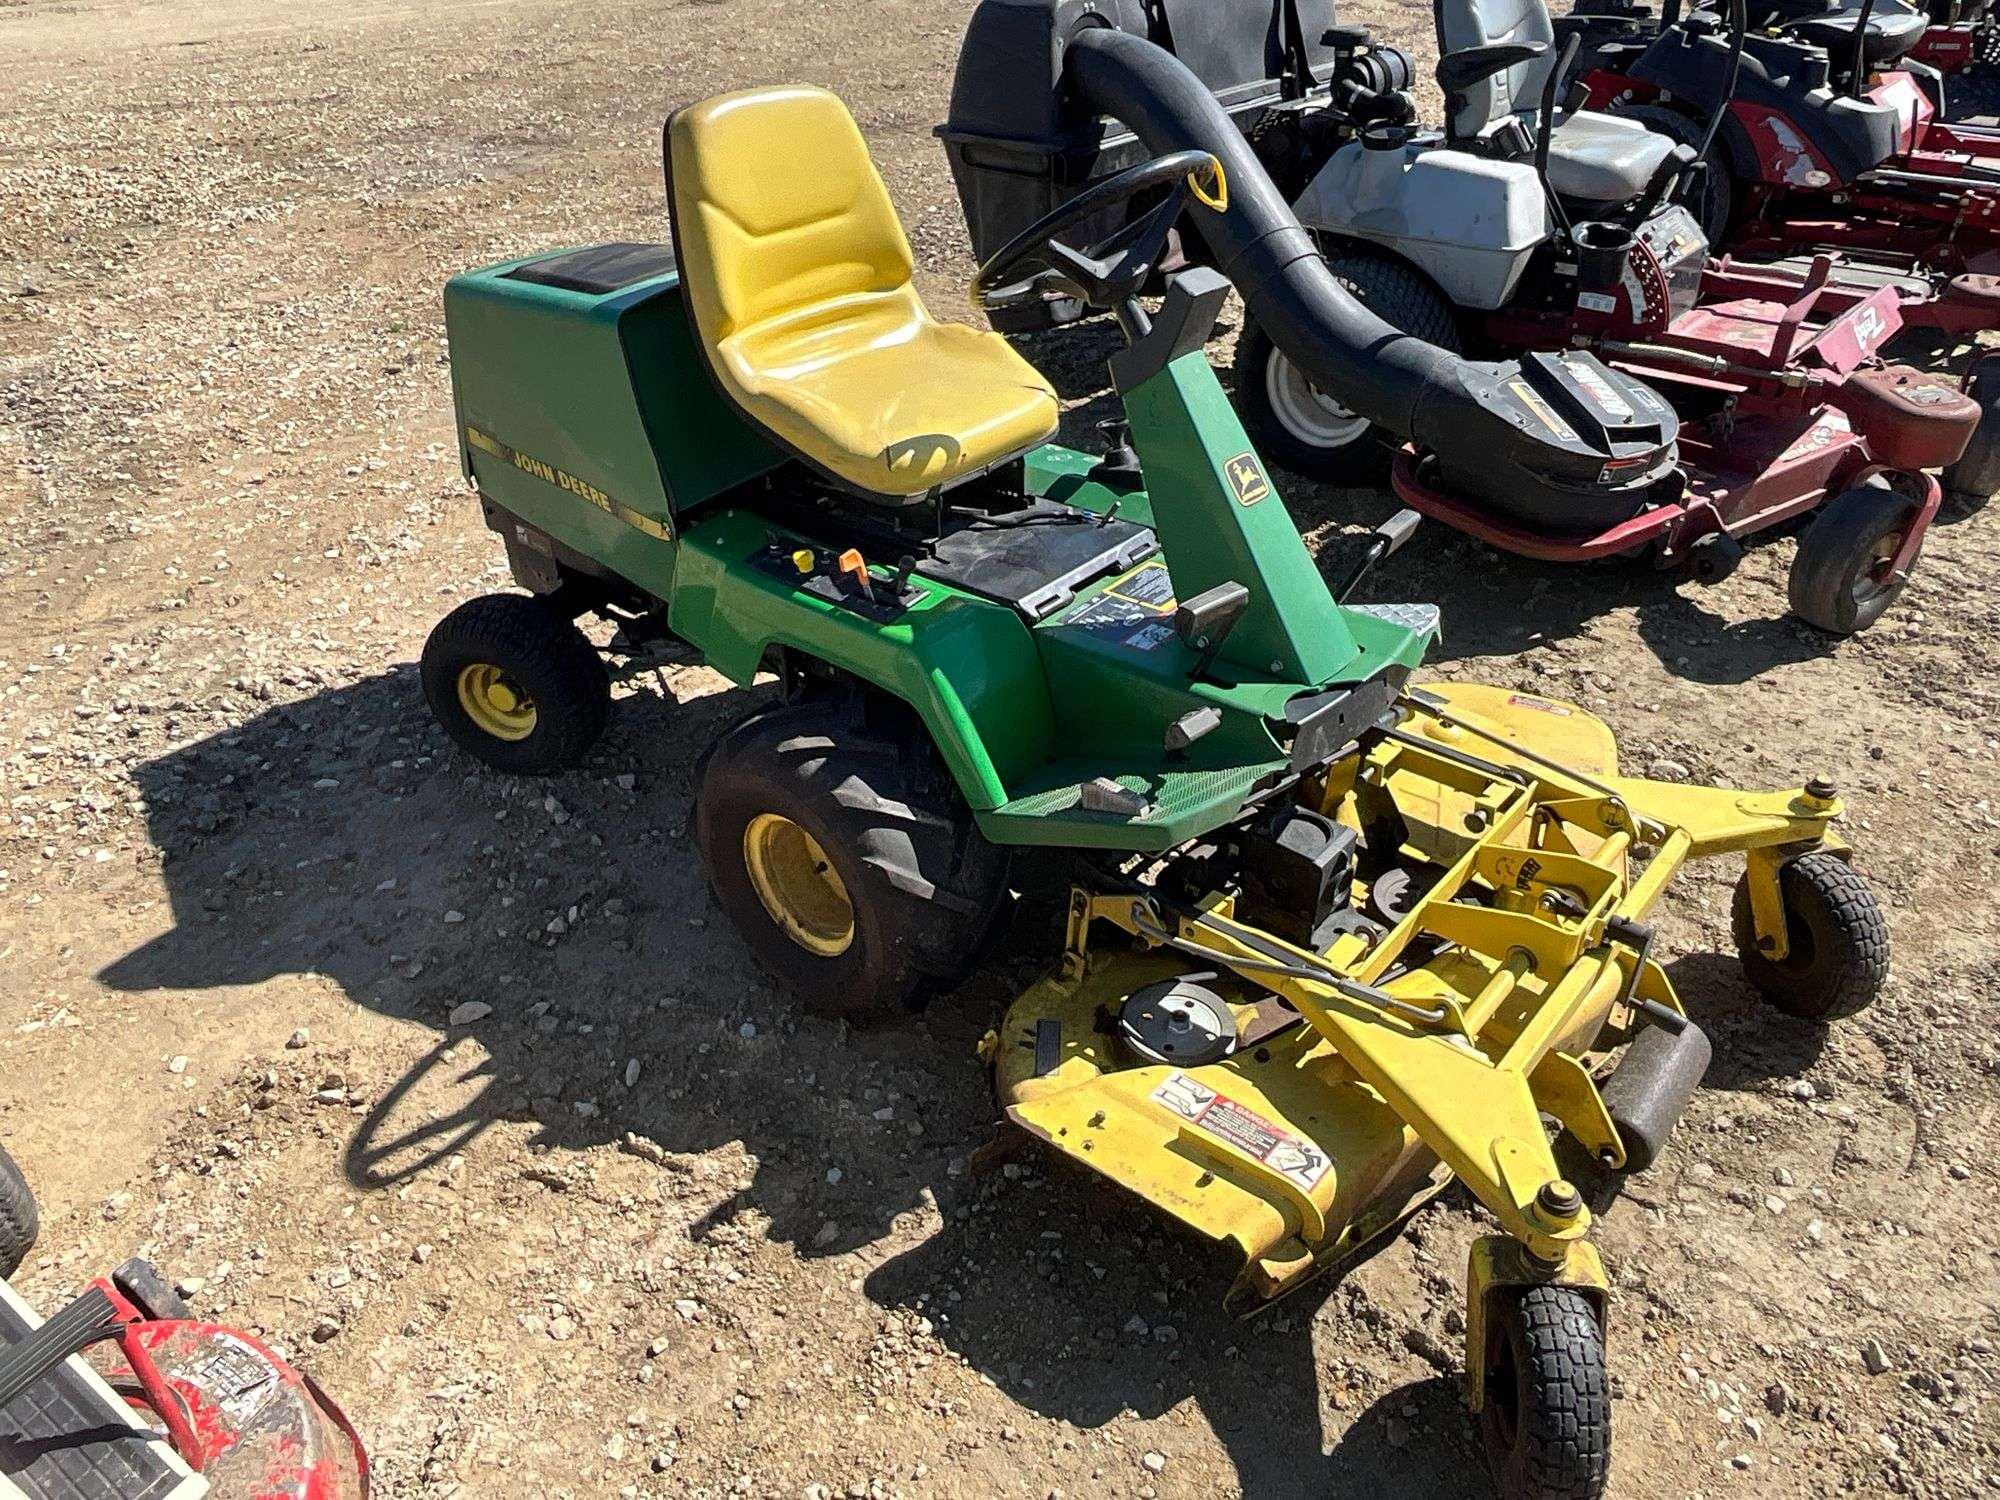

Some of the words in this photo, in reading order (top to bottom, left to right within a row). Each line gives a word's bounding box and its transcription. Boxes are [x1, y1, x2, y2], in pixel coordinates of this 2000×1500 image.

[514, 450, 556, 485] JOHN
[557, 469, 612, 513] DEERE
[1234, 1104, 1274, 1129] DANGE
